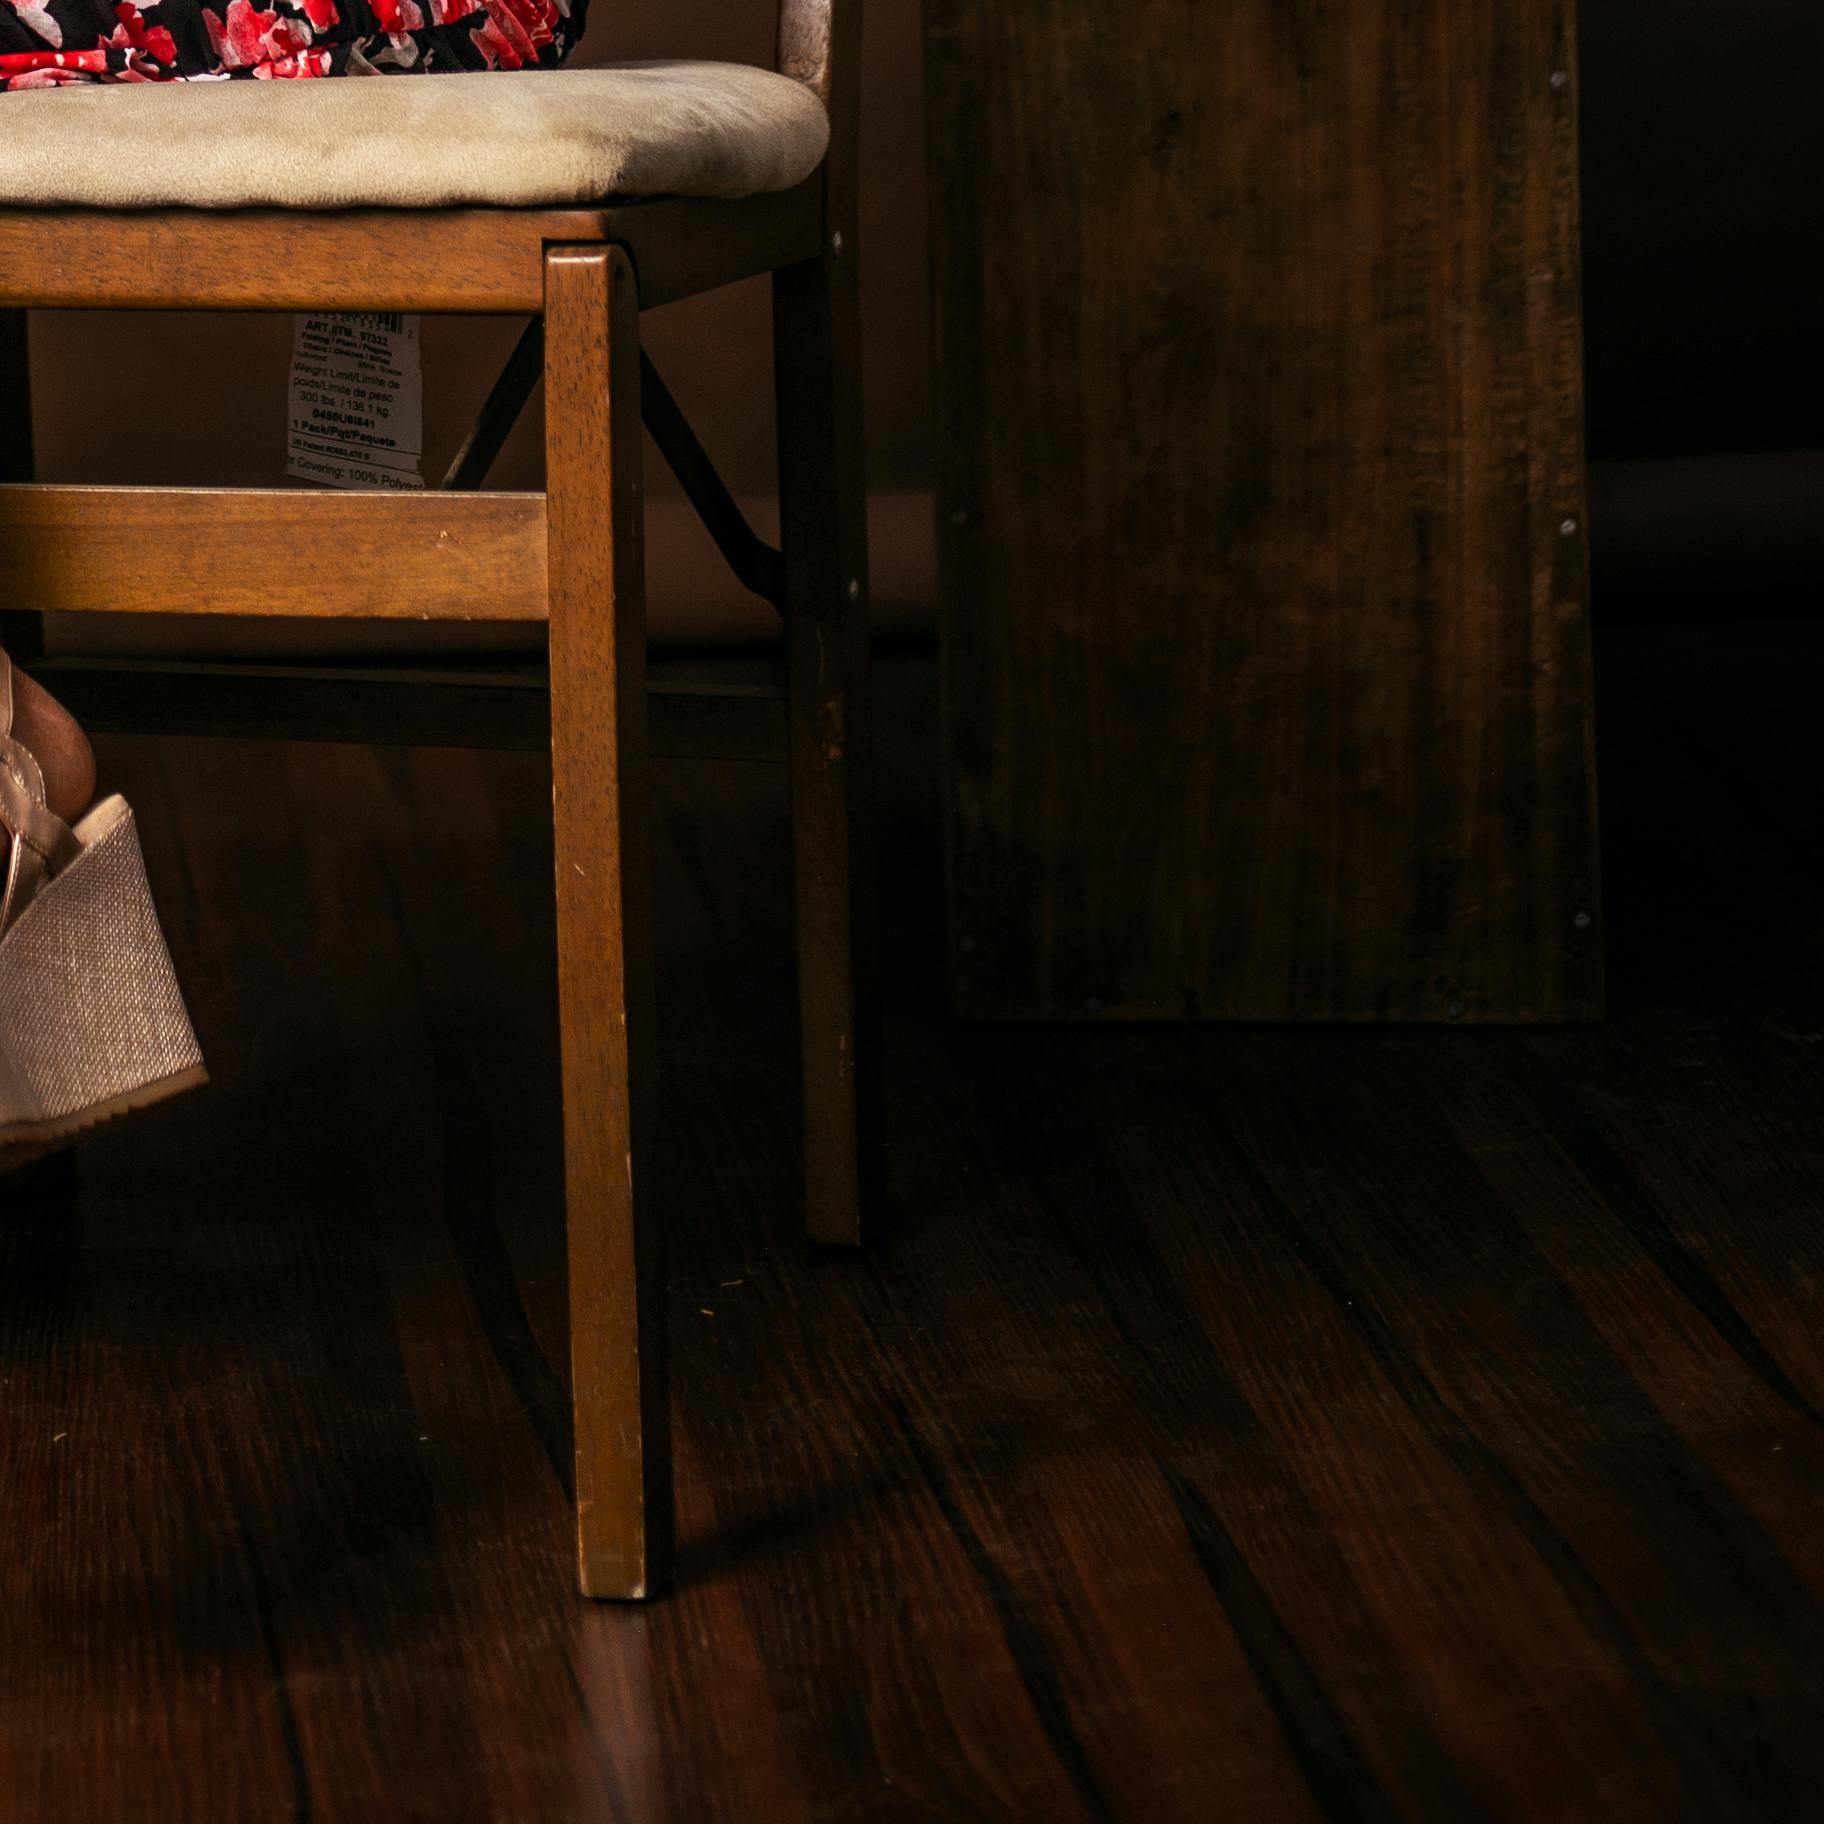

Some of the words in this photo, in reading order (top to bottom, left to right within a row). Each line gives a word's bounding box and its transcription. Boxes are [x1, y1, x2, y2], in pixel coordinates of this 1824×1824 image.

[302, 332, 330, 345] Folding
[303, 342, 328, 353] Chairs
[293, 361, 328, 377] Weight
[331, 368, 385, 387] Limit/Limite
[387, 379, 400, 390] de
[293, 376, 351, 395] poids/Limite
[353, 387, 366, 398] de
[369, 391, 394, 403] peso
[299, 391, 318, 402] 300
[293, 419, 298, 428] 1
[302, 421, 396, 447] Pack/Pqt/Paquete
[302, 440, 325, 451] Patent
[297, 457, 345, 479] Covering:
[348, 468, 378, 485] 100%
